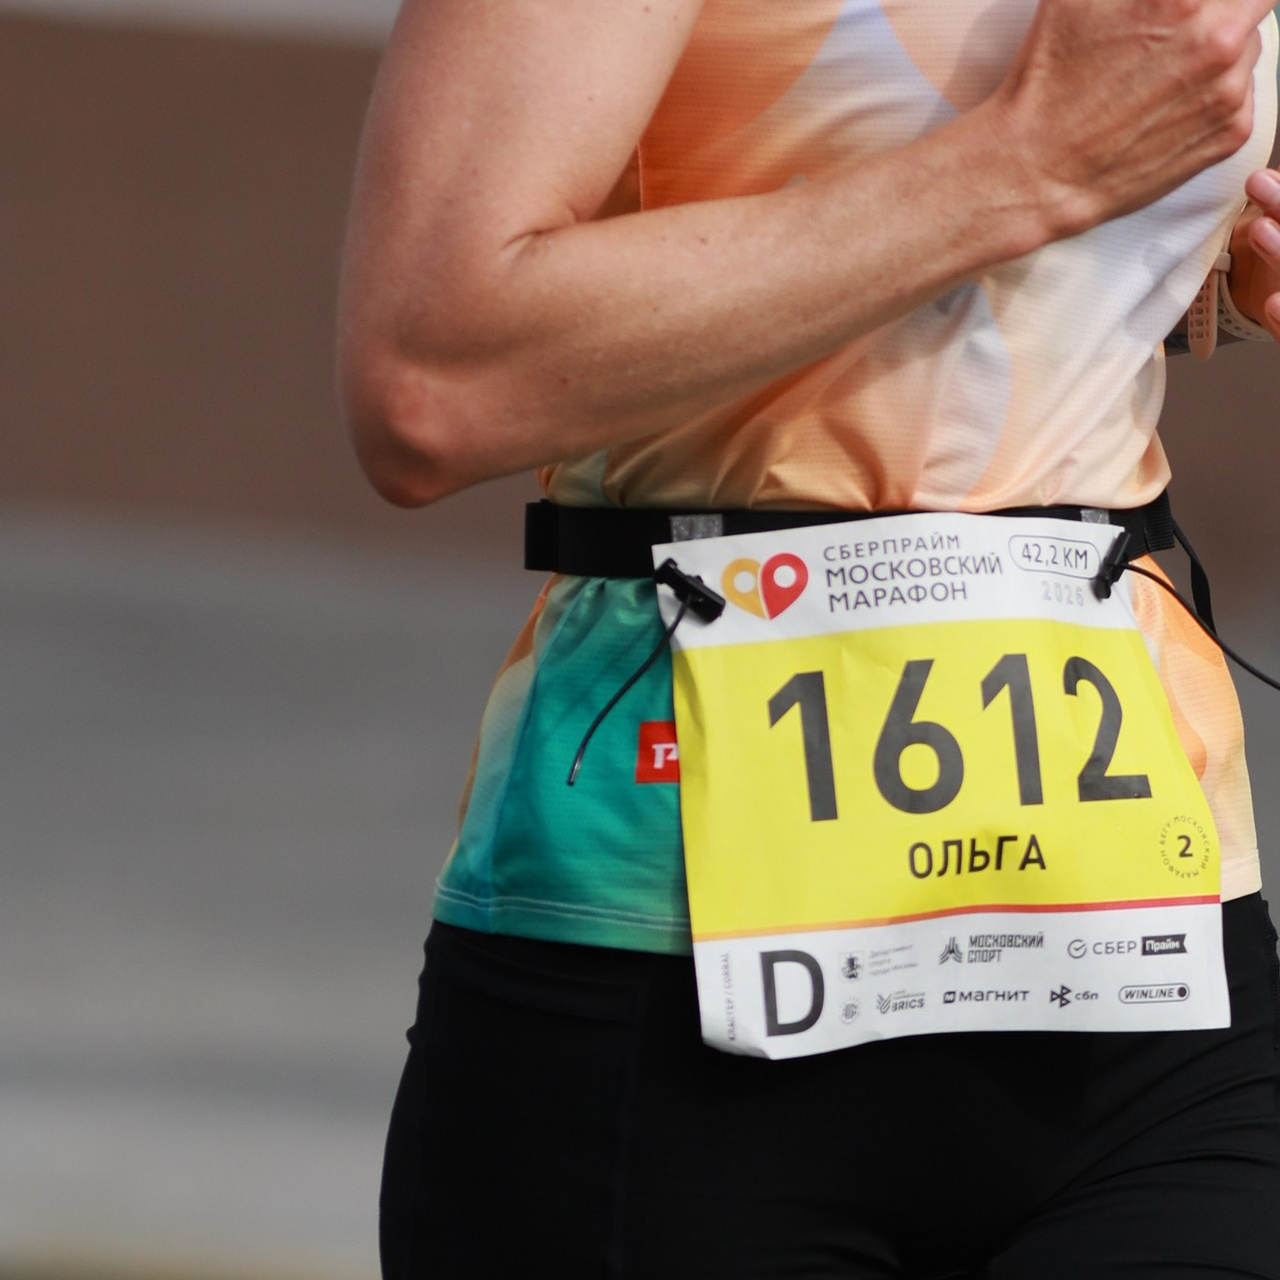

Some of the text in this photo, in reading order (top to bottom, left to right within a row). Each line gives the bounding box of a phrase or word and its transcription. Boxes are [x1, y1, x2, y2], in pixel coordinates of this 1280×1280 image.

[823, 532, 961, 562] СБЕРПРАЙМ
[1022, 543, 1058, 566] 42,2
[826, 552, 1003, 587] МОСКОВСКИЙ
[829, 581, 968, 613] МАРАФОН
[767, 653, 1153, 822] 1612
[908, 834, 1047, 878] ОЛЬГА
[1177, 834, 1193, 858] 2
[968, 931, 1044, 949] МОСКОВСКИЙ
[1092, 938, 1181, 955] СБЕР Прайм
[967, 949, 1003, 963] СПОРТ
[759, 949, 825, 1037] D
[1075, 989, 1098, 1001] сбп
[1124, 988, 1174, 1000] WINLINE
[891, 998, 925, 1012] BRICS
